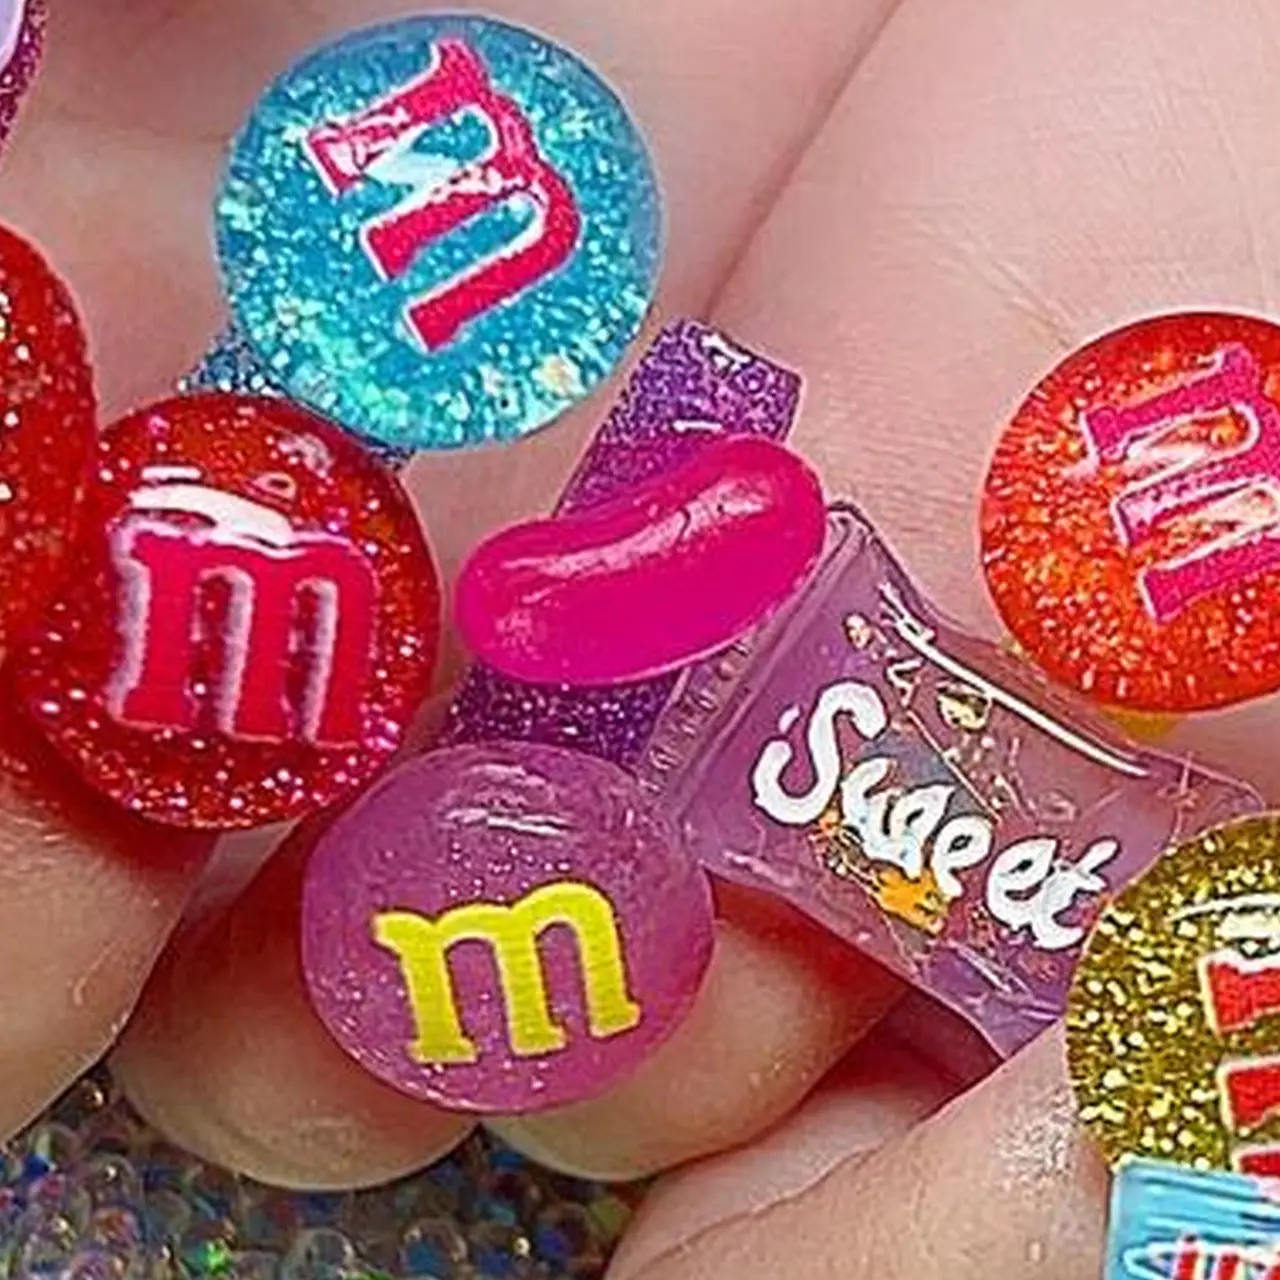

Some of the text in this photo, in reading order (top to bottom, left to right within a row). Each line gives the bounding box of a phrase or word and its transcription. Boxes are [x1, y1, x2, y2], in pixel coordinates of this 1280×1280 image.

[107, 520, 380, 746] m
[753, 680, 1119, 950] Sweet
[369, 878, 641, 1065] m
